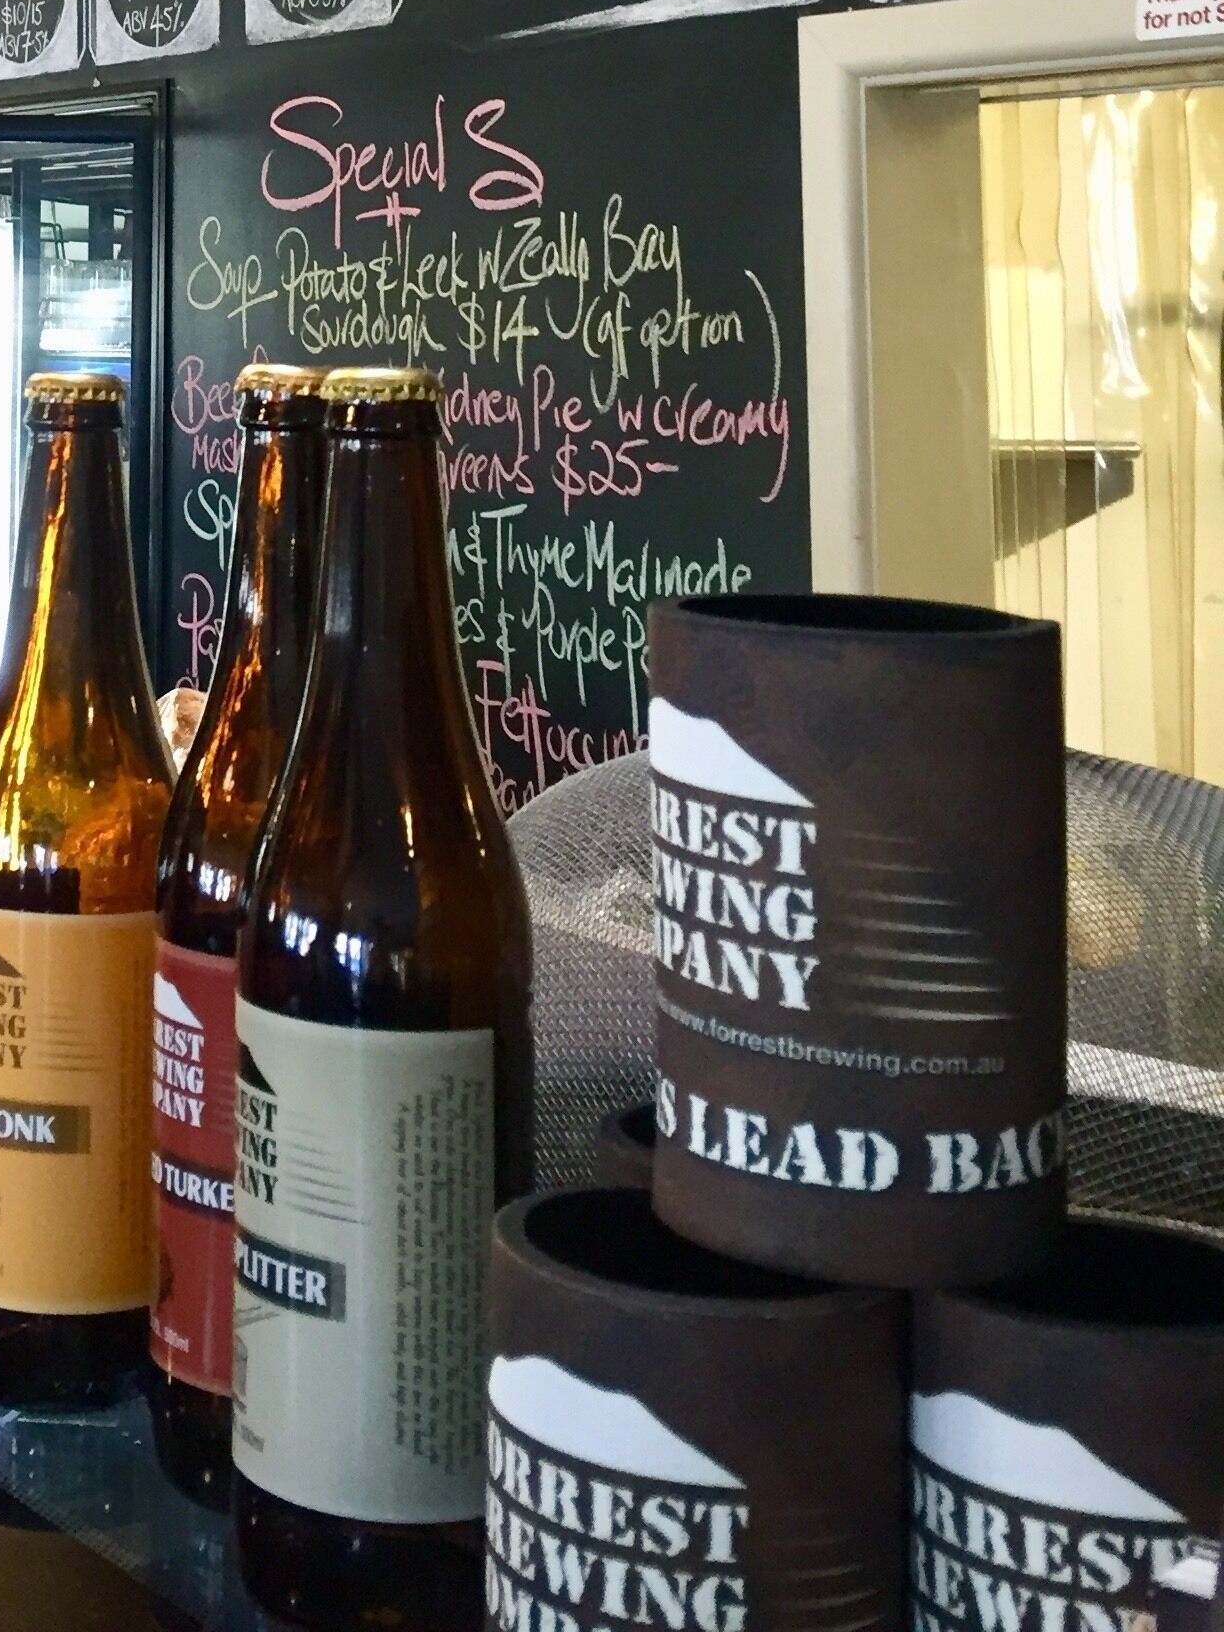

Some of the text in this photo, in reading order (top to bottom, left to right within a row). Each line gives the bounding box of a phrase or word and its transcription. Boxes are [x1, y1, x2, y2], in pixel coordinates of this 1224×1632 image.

[122, 5, 149, 36] ABV
[1143, 10, 1173, 30] for
[1177, 5, 1212, 27] not
[187, 215, 279, 349] Soup
[276, 226, 368, 336] Potato
[400, 223, 468, 309] Leek
[603, 193, 684, 323] Bay
[439, 367, 527, 464] idney
[533, 363, 592, 453] Pie
[533, 581, 623, 707] Purple
[650, 780, 818, 876] REST
[165, 1162, 234, 1213] TURKE
[687, 1093, 901, 1192] LEAD
